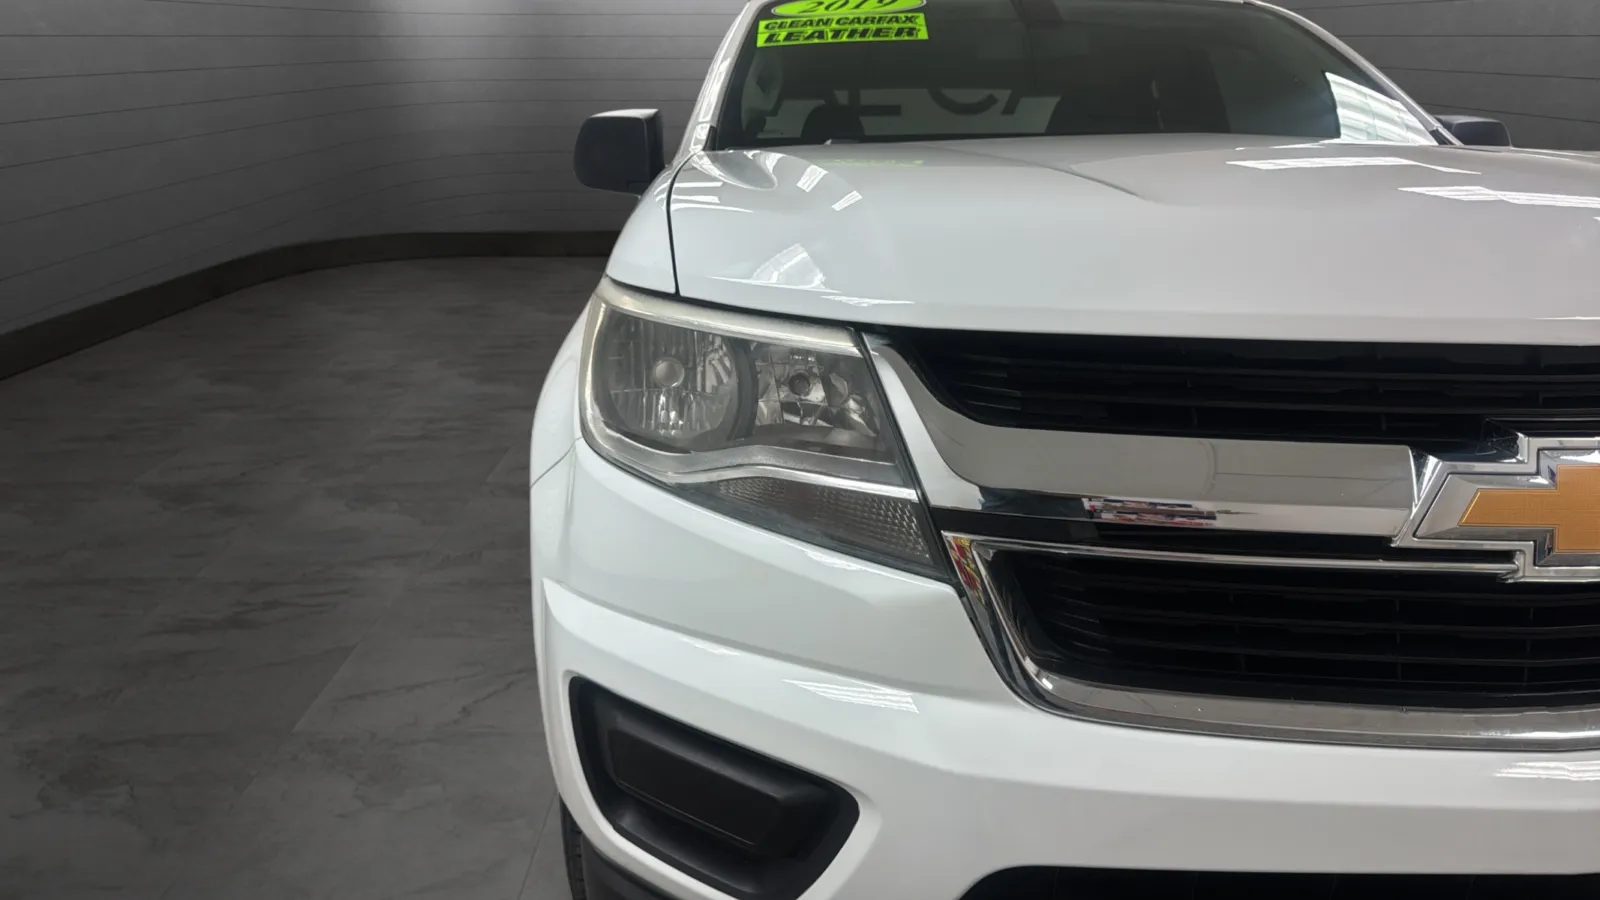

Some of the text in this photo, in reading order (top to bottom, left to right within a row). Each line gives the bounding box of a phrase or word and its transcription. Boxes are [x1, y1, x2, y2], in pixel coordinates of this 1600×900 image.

[764, 15, 918, 30] CLEAN CARFAX
[764, 27, 920, 44] LEATHER
